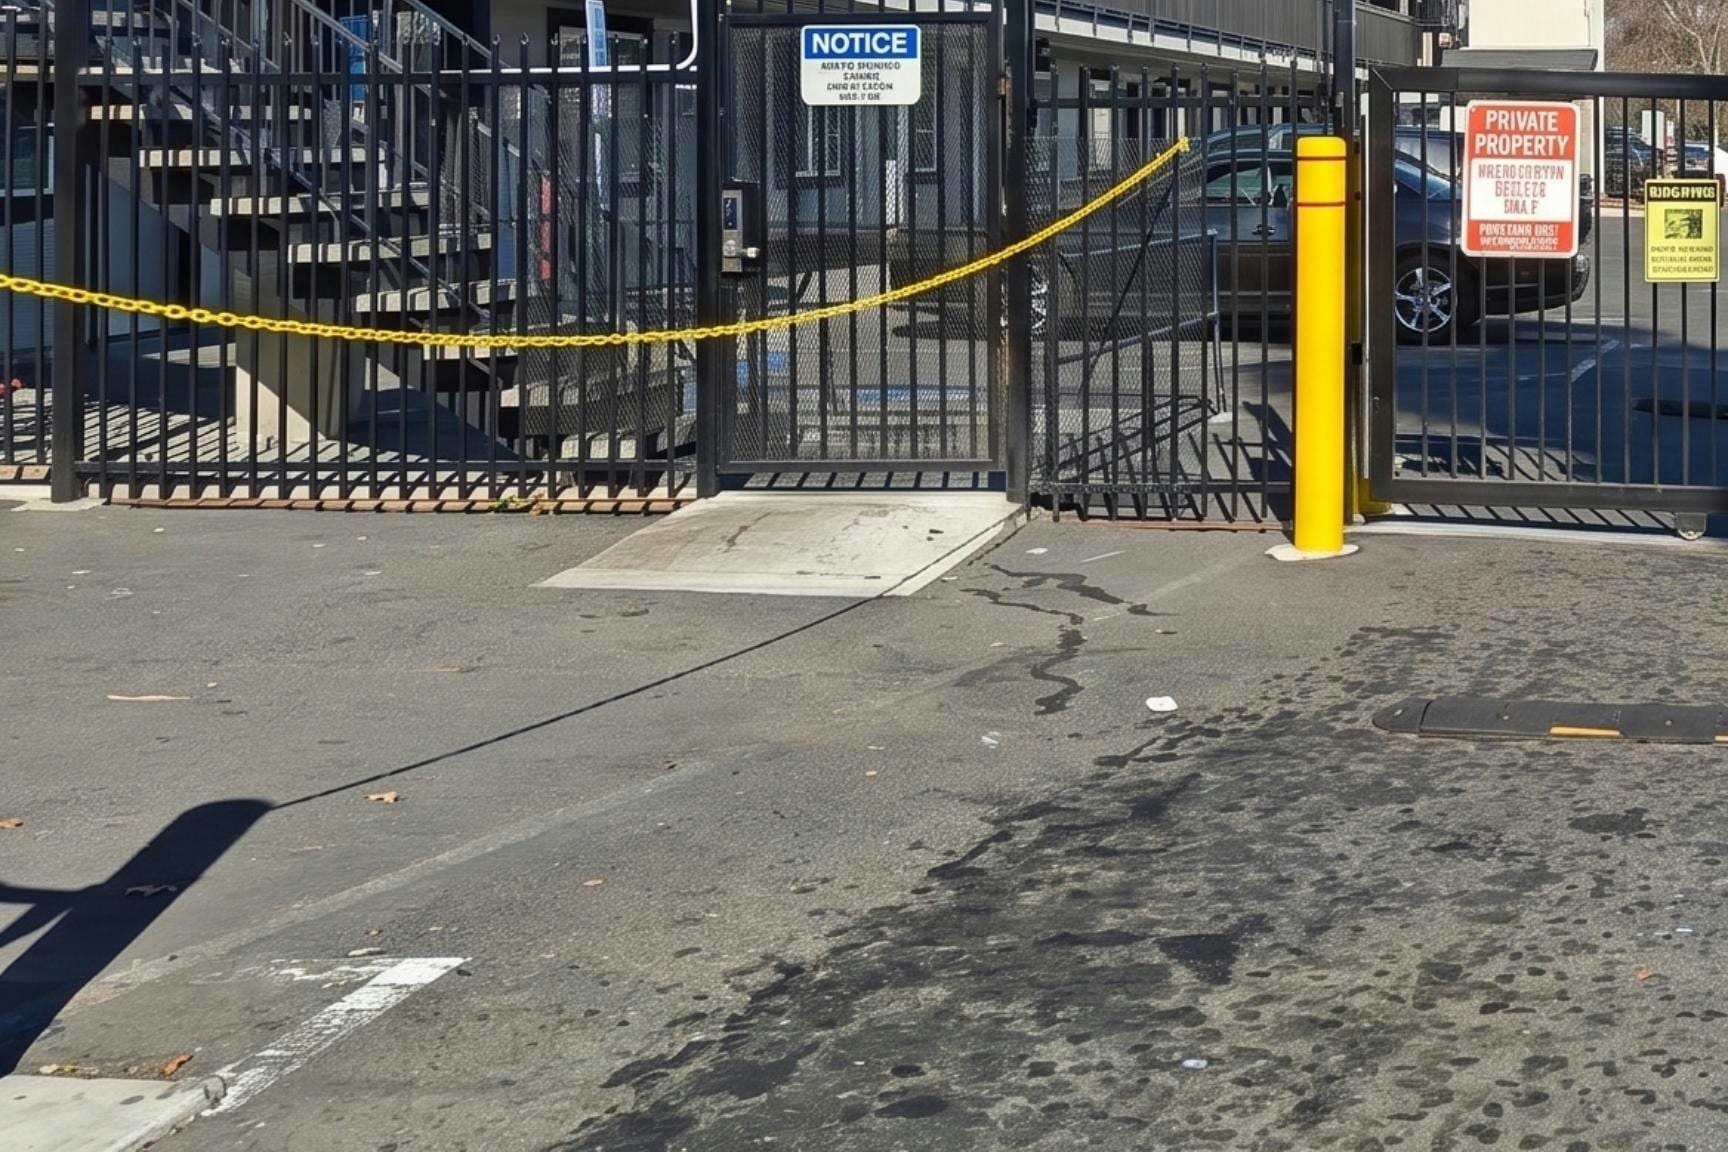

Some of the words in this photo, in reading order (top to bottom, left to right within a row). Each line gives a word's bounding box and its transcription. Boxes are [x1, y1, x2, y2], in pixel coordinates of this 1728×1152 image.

[812, 32, 908, 54] NOTICE
[1485, 109, 1559, 132] PRIVATE
[1475, 133, 1569, 156] PROPERTY
